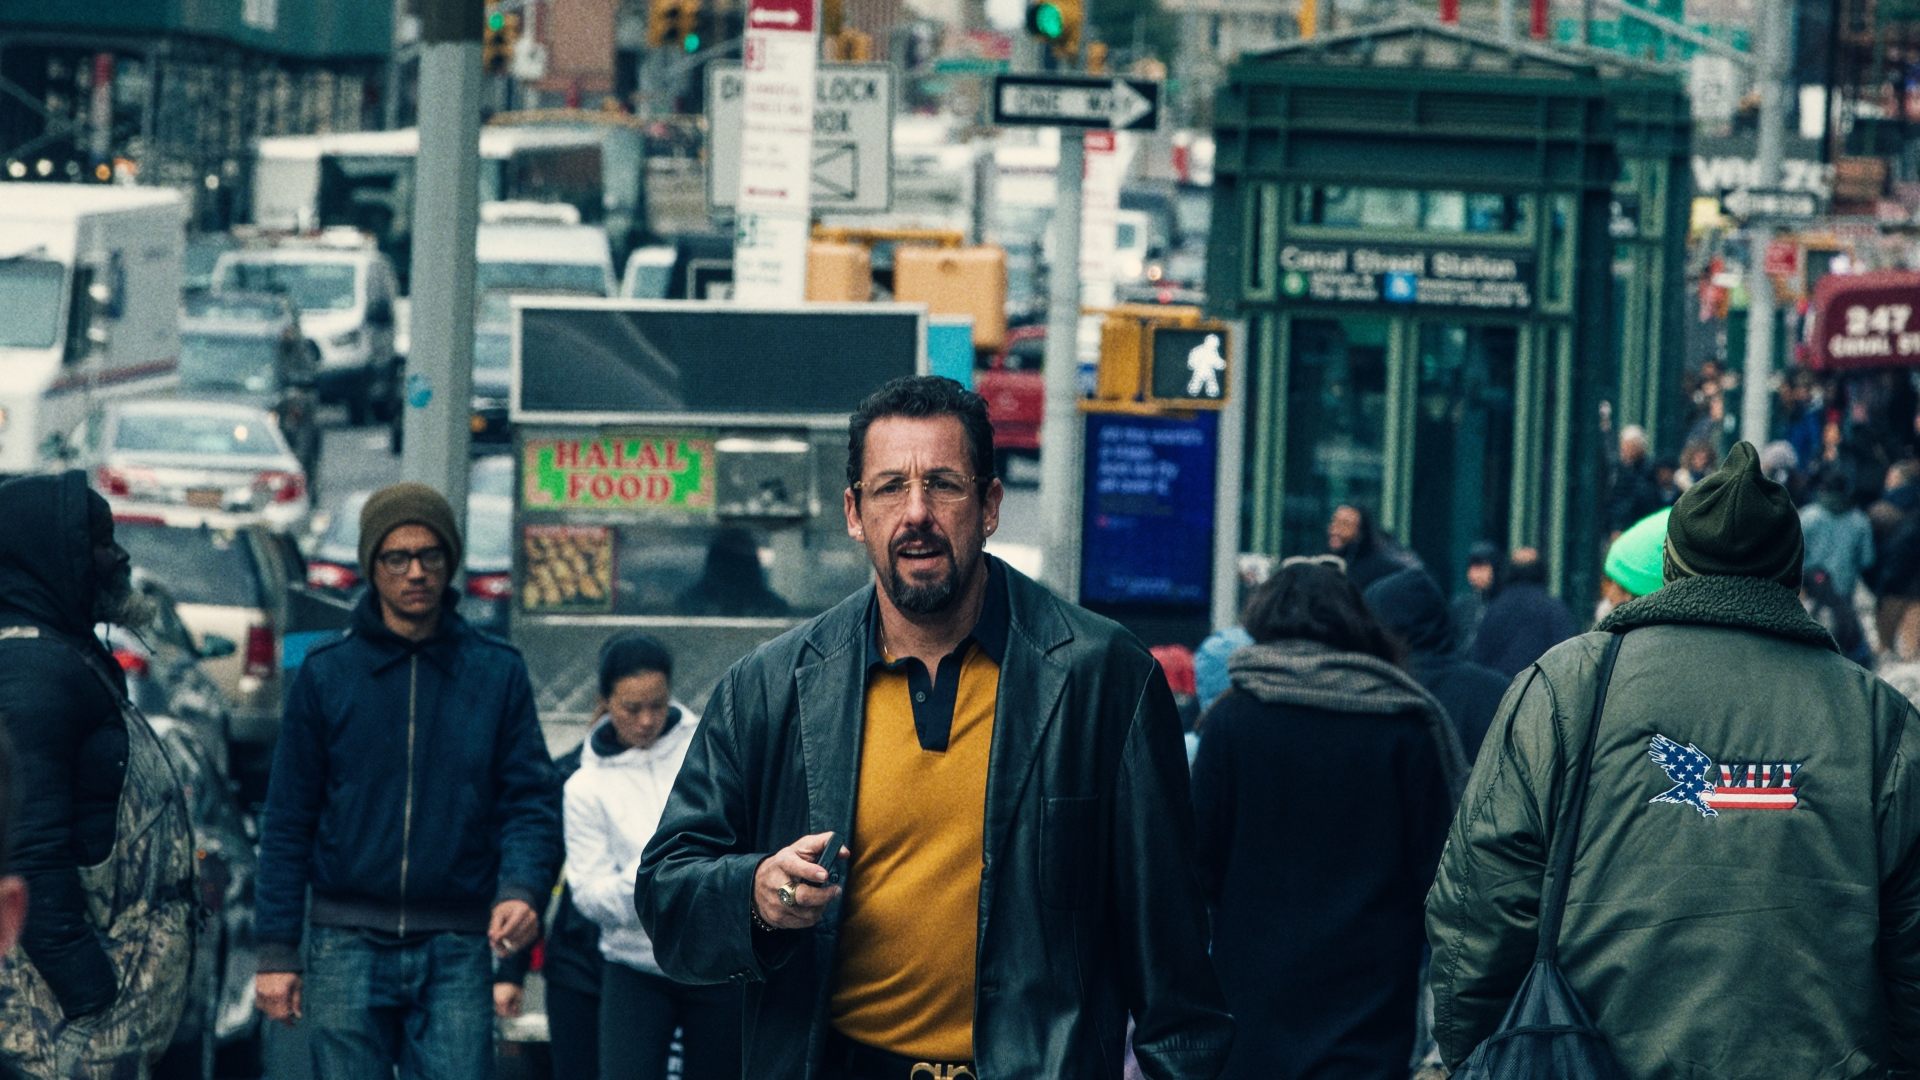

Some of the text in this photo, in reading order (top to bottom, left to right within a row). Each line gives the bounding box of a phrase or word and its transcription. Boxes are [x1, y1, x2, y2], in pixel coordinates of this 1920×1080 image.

[816, 77, 878, 101] LOCK
[1016, 89, 1060, 116] ONE
[1280, 246, 1517, 279] Canal Street Station
[1845, 304, 1912, 337] 247
[1828, 333, 1892, 358] CANAL
[556, 440, 688, 471] HALAL
[568, 473, 673, 501] FOOD
[1713, 763, 1802, 788] NAVY
